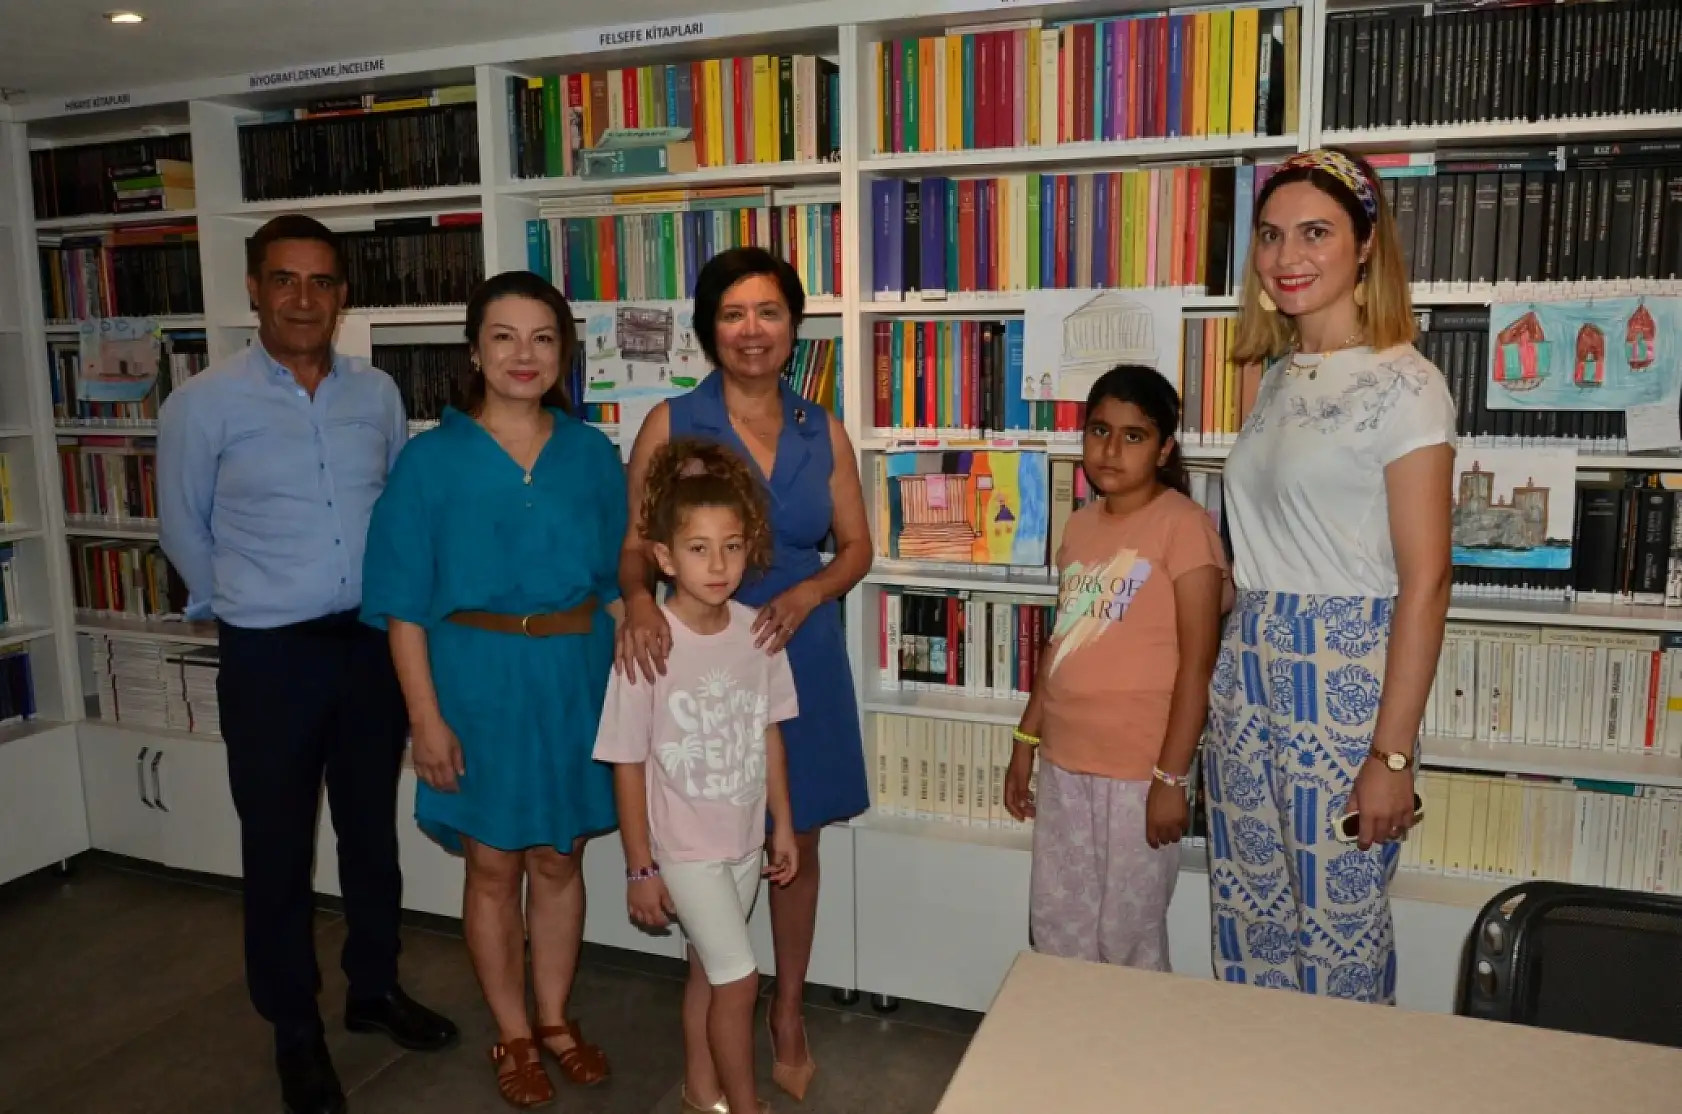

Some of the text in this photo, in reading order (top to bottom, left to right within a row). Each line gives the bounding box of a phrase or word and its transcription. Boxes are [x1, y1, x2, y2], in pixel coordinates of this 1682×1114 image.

[599, 23, 703, 46] FELSEFE KİTAPLARI
[1110, 577, 1144, 598] OF
[1081, 599, 1130, 622] ART
